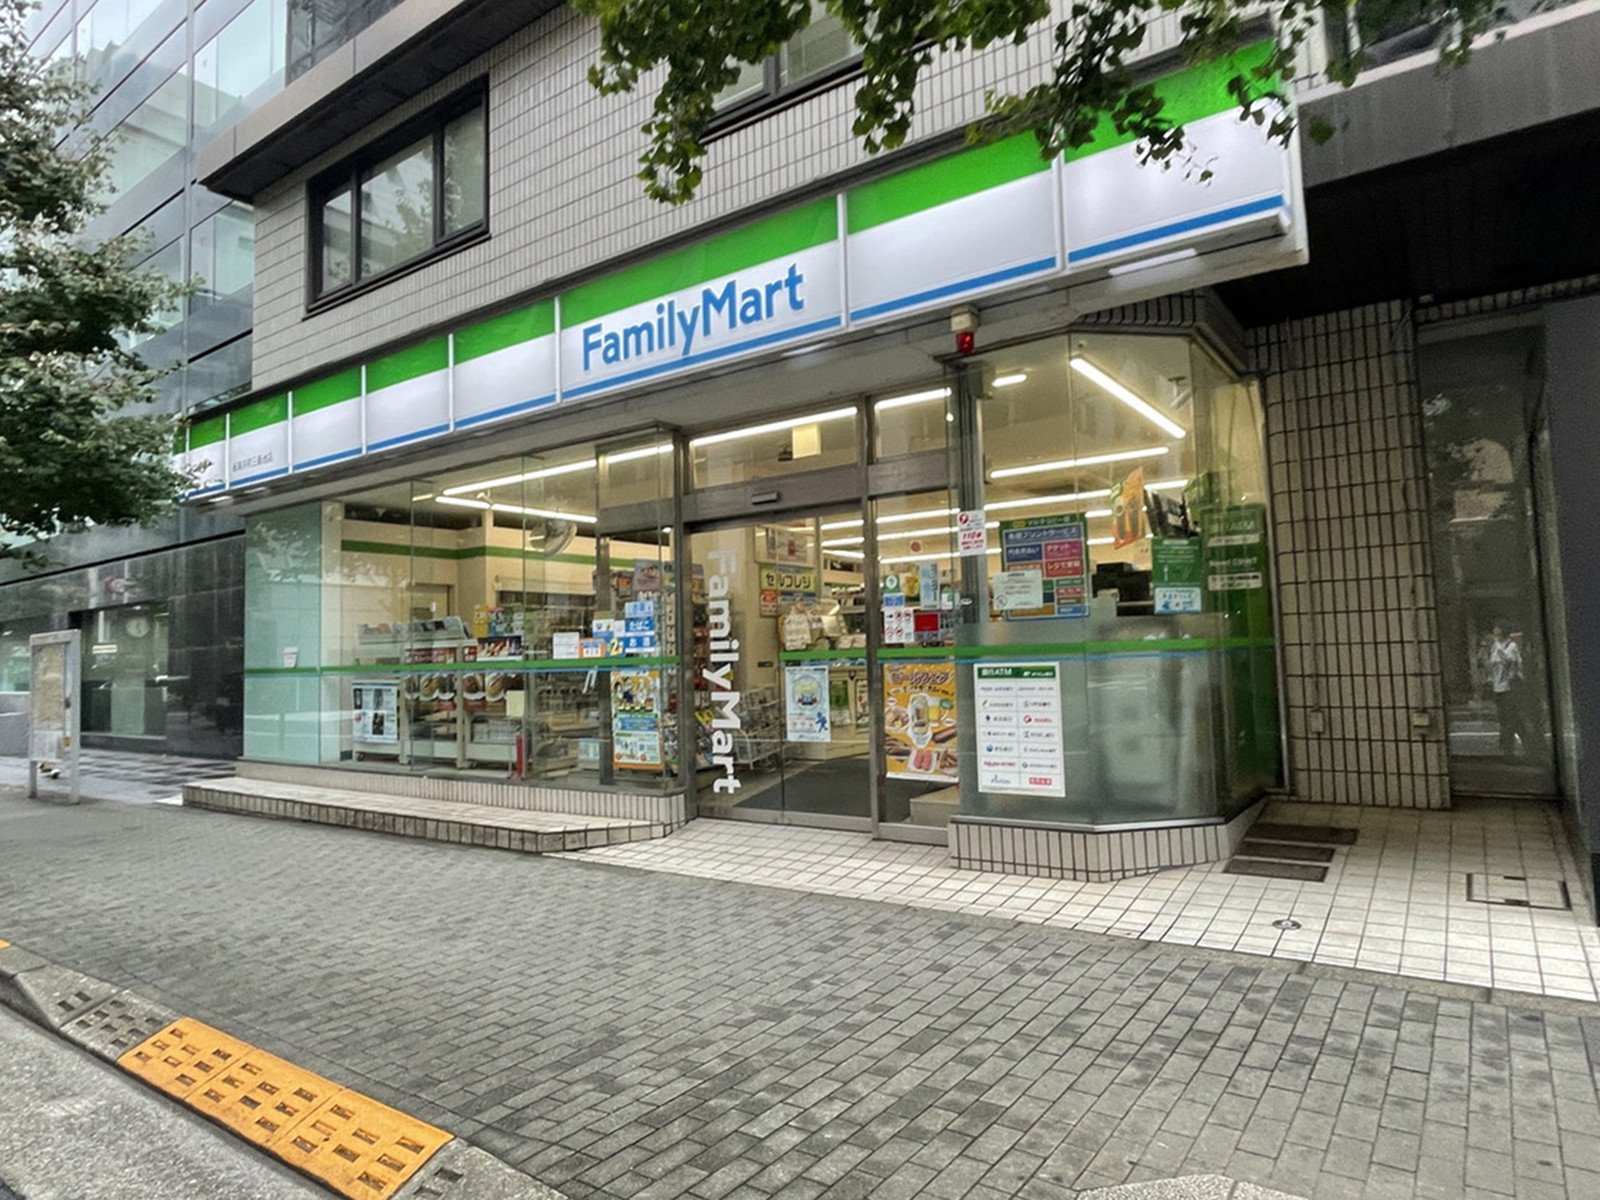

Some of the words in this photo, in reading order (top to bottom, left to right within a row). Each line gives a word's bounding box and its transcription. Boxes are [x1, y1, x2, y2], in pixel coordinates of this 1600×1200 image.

[583, 263, 804, 371] FamilyMart
[629, 620, 650, 631] たばこ
[702, 550, 741, 794] FamilyMart
